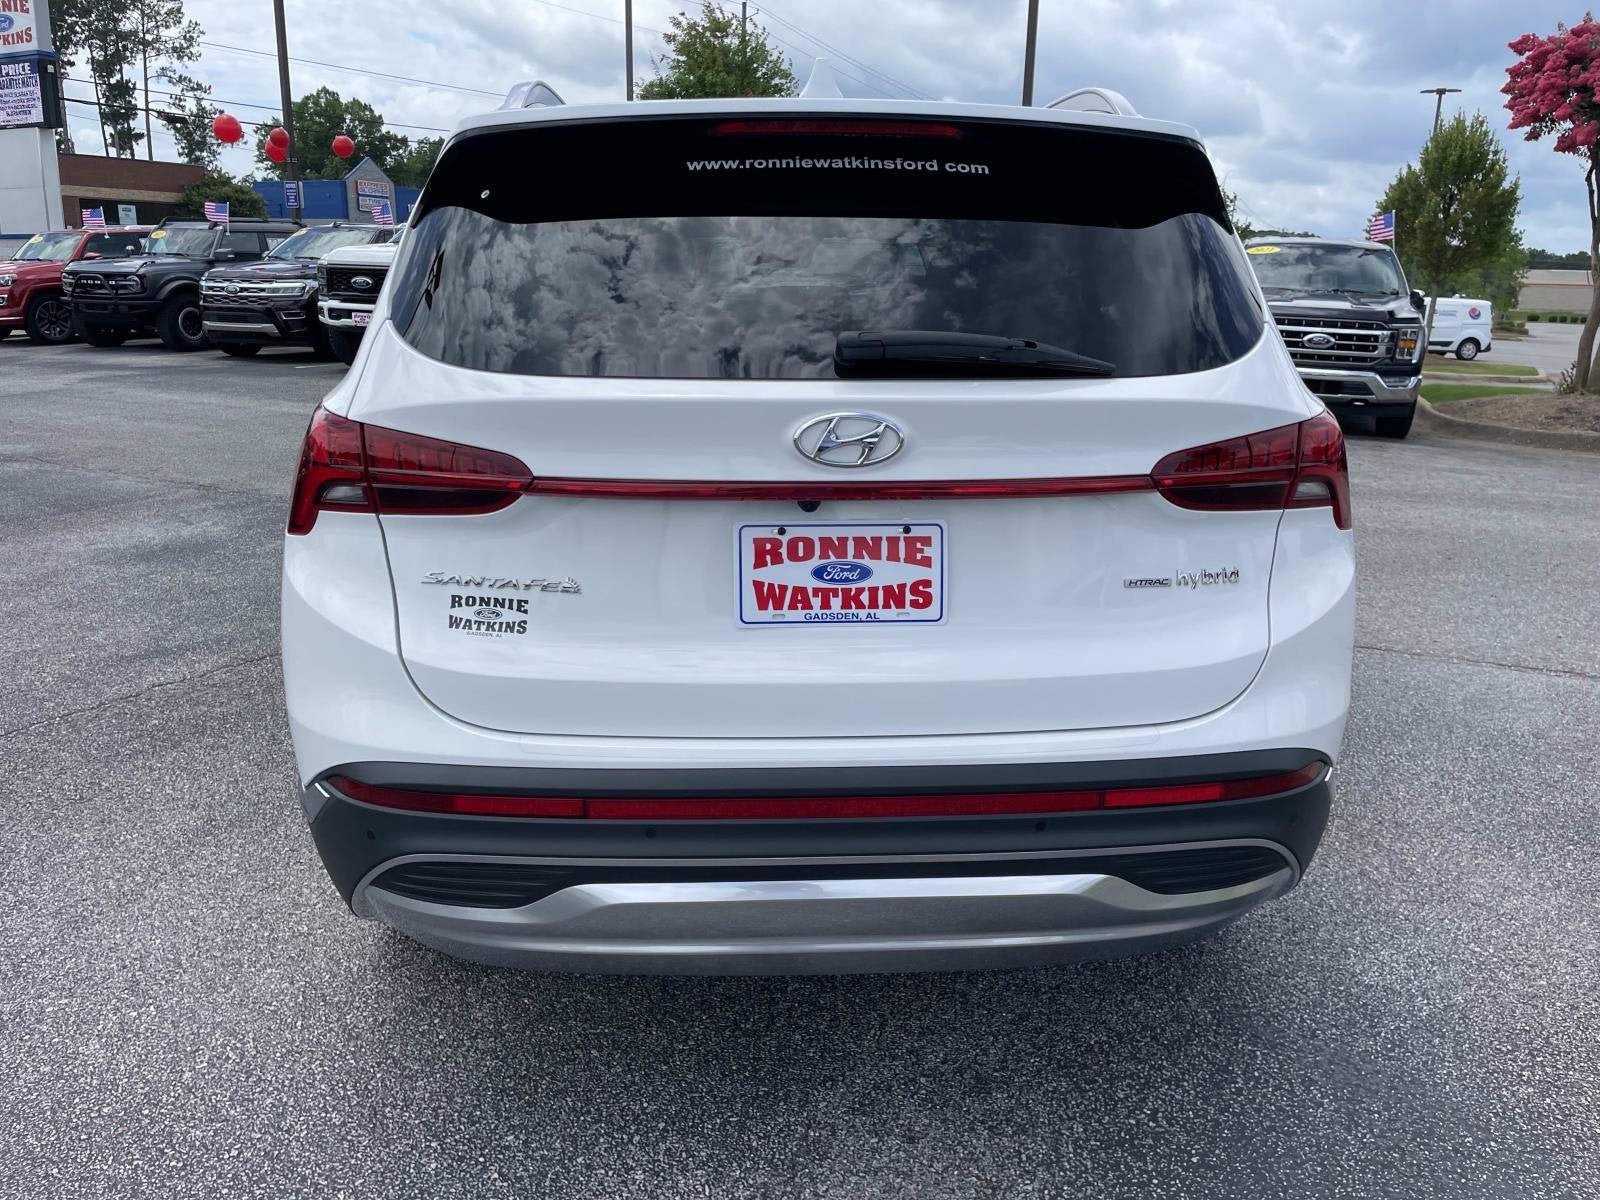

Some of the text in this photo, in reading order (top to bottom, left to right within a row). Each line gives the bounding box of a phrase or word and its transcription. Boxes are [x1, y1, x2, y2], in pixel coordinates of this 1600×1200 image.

[0, 0, 30, 14] NIE
[0, 26, 33, 46] KINS
[1, 62, 31, 77] PRICE
[752, 536, 933, 570] RONNIE
[823, 565, 861, 580] Ford
[1128, 567, 1240, 590] HTRAC hybrid
[450, 594, 529, 615] RONNIE
[752, 579, 933, 611] WATKINS
[448, 614, 528, 635] WATKINS
[804, 612, 880, 621] GADSDEN, AL
